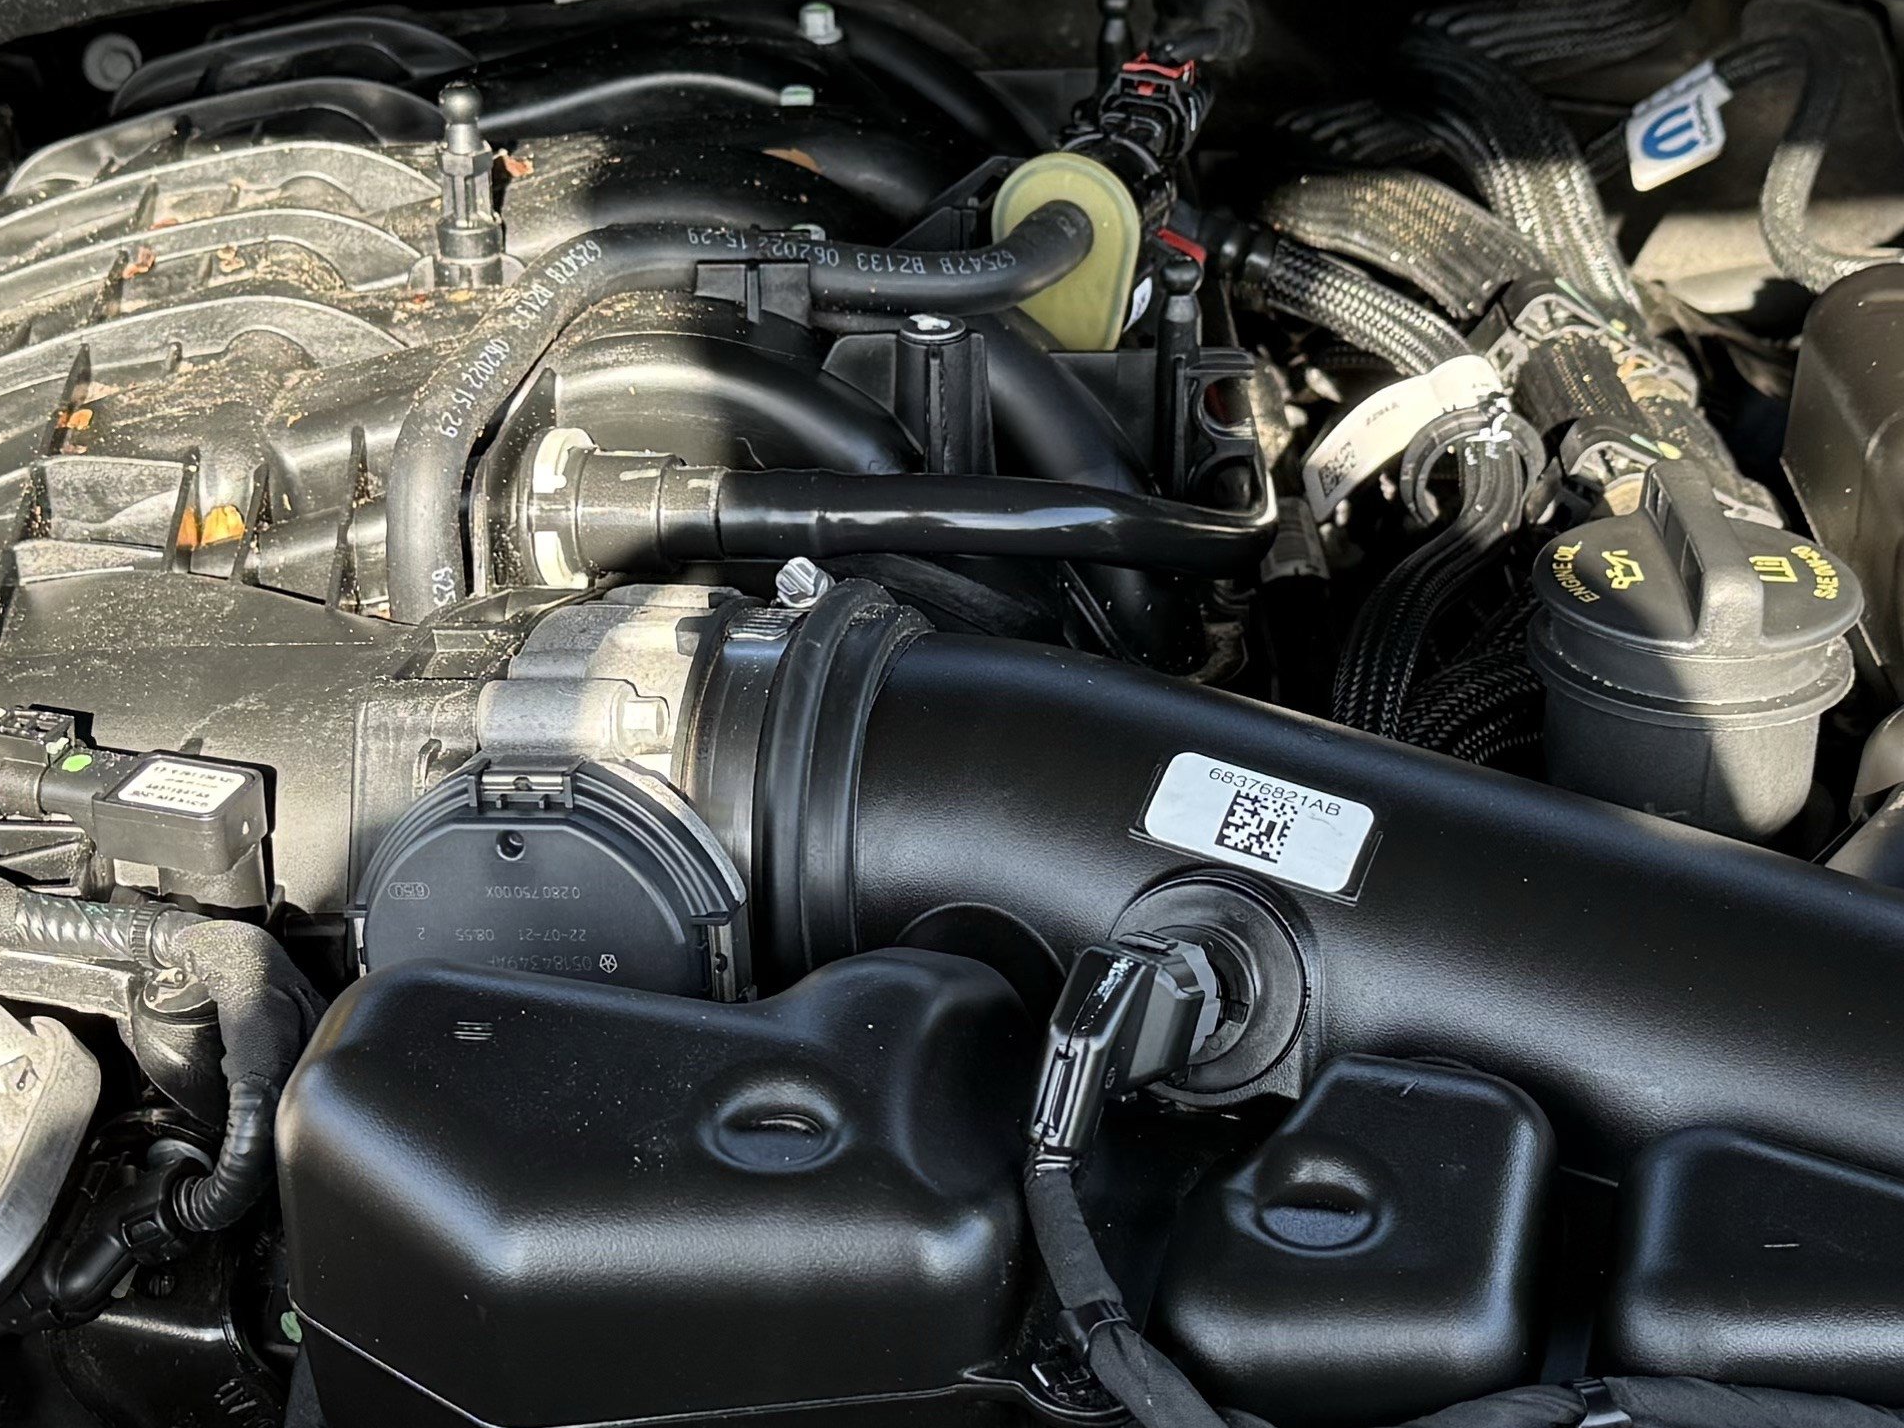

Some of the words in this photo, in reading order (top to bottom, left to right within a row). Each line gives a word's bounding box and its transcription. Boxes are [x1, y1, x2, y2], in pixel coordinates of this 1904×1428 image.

[1553, 540, 1583, 562] OIL
[1552, 562, 1600, 603] ENGINE
[1812, 575, 1839, 600] SAE
[1208, 766, 1343, 818] 68376821AB
